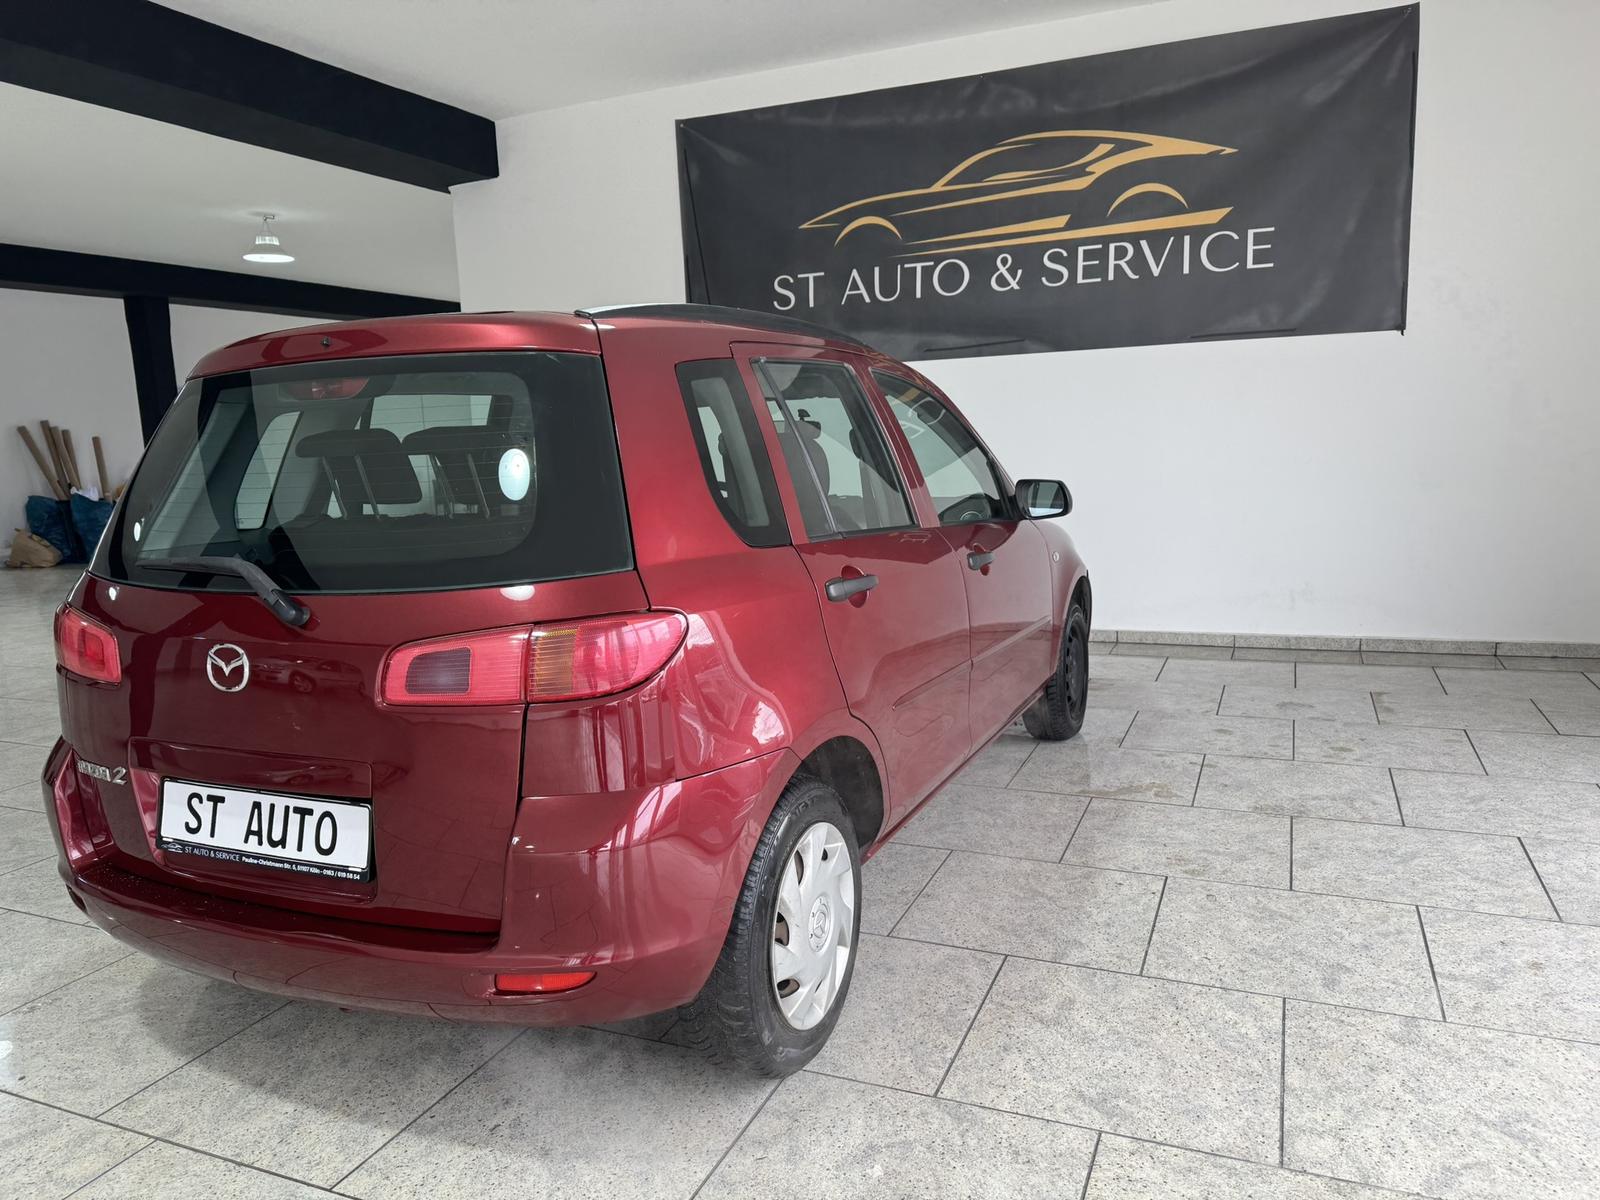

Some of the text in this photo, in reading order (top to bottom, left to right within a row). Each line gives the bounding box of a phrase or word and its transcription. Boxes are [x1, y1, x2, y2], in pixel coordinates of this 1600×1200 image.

[773, 227, 1275, 311] ST AUTO & SERVICE
[184, 792, 338, 856] ST AUTO
[184, 846, 240, 862] ST AUTO & SERVICE
